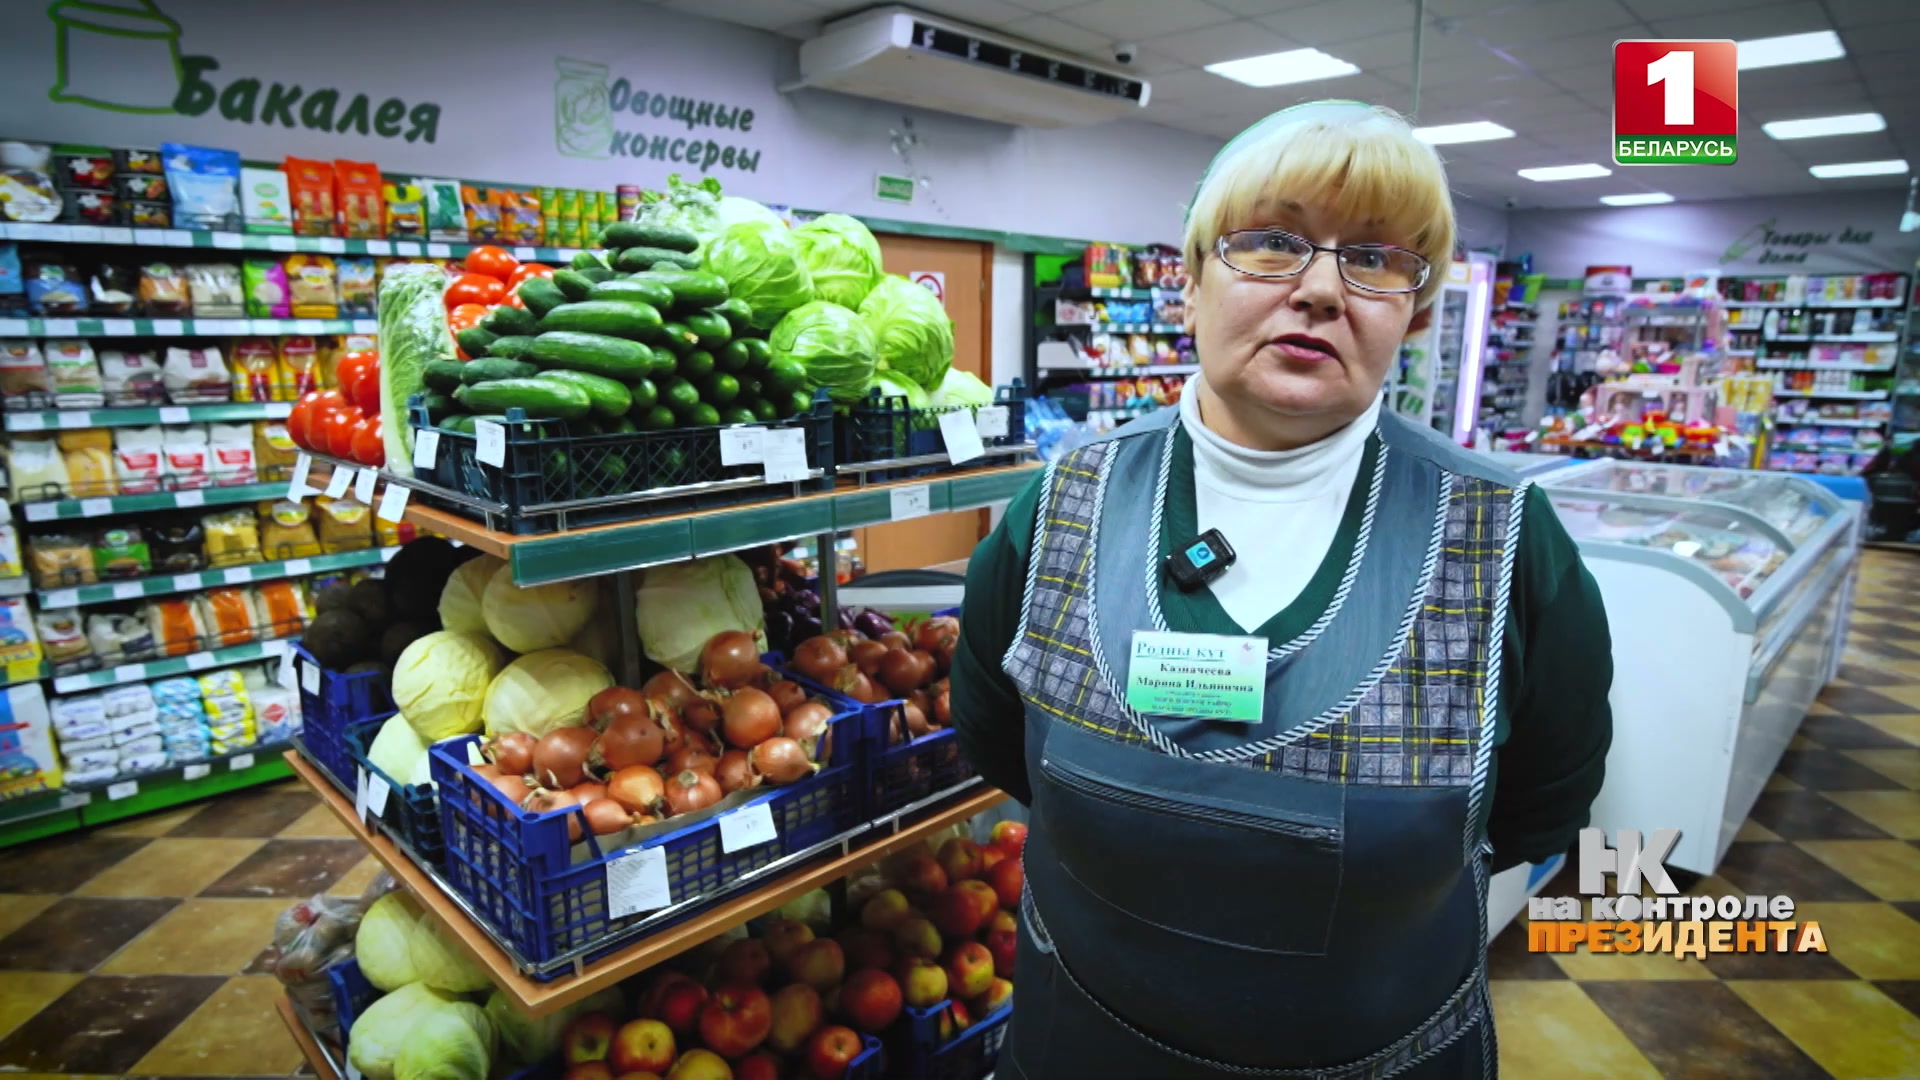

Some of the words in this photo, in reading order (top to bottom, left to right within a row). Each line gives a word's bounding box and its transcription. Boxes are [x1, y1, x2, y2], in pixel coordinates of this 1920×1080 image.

[172, 55, 441, 144] Бакалея
[609, 77, 755, 132] Овощные
[610, 130, 761, 173] консервы
[1136, 676, 1181, 688] Марина
[1186, 679, 1254, 693] Ильинична
[1160, 663, 1231, 676] Казначеева
